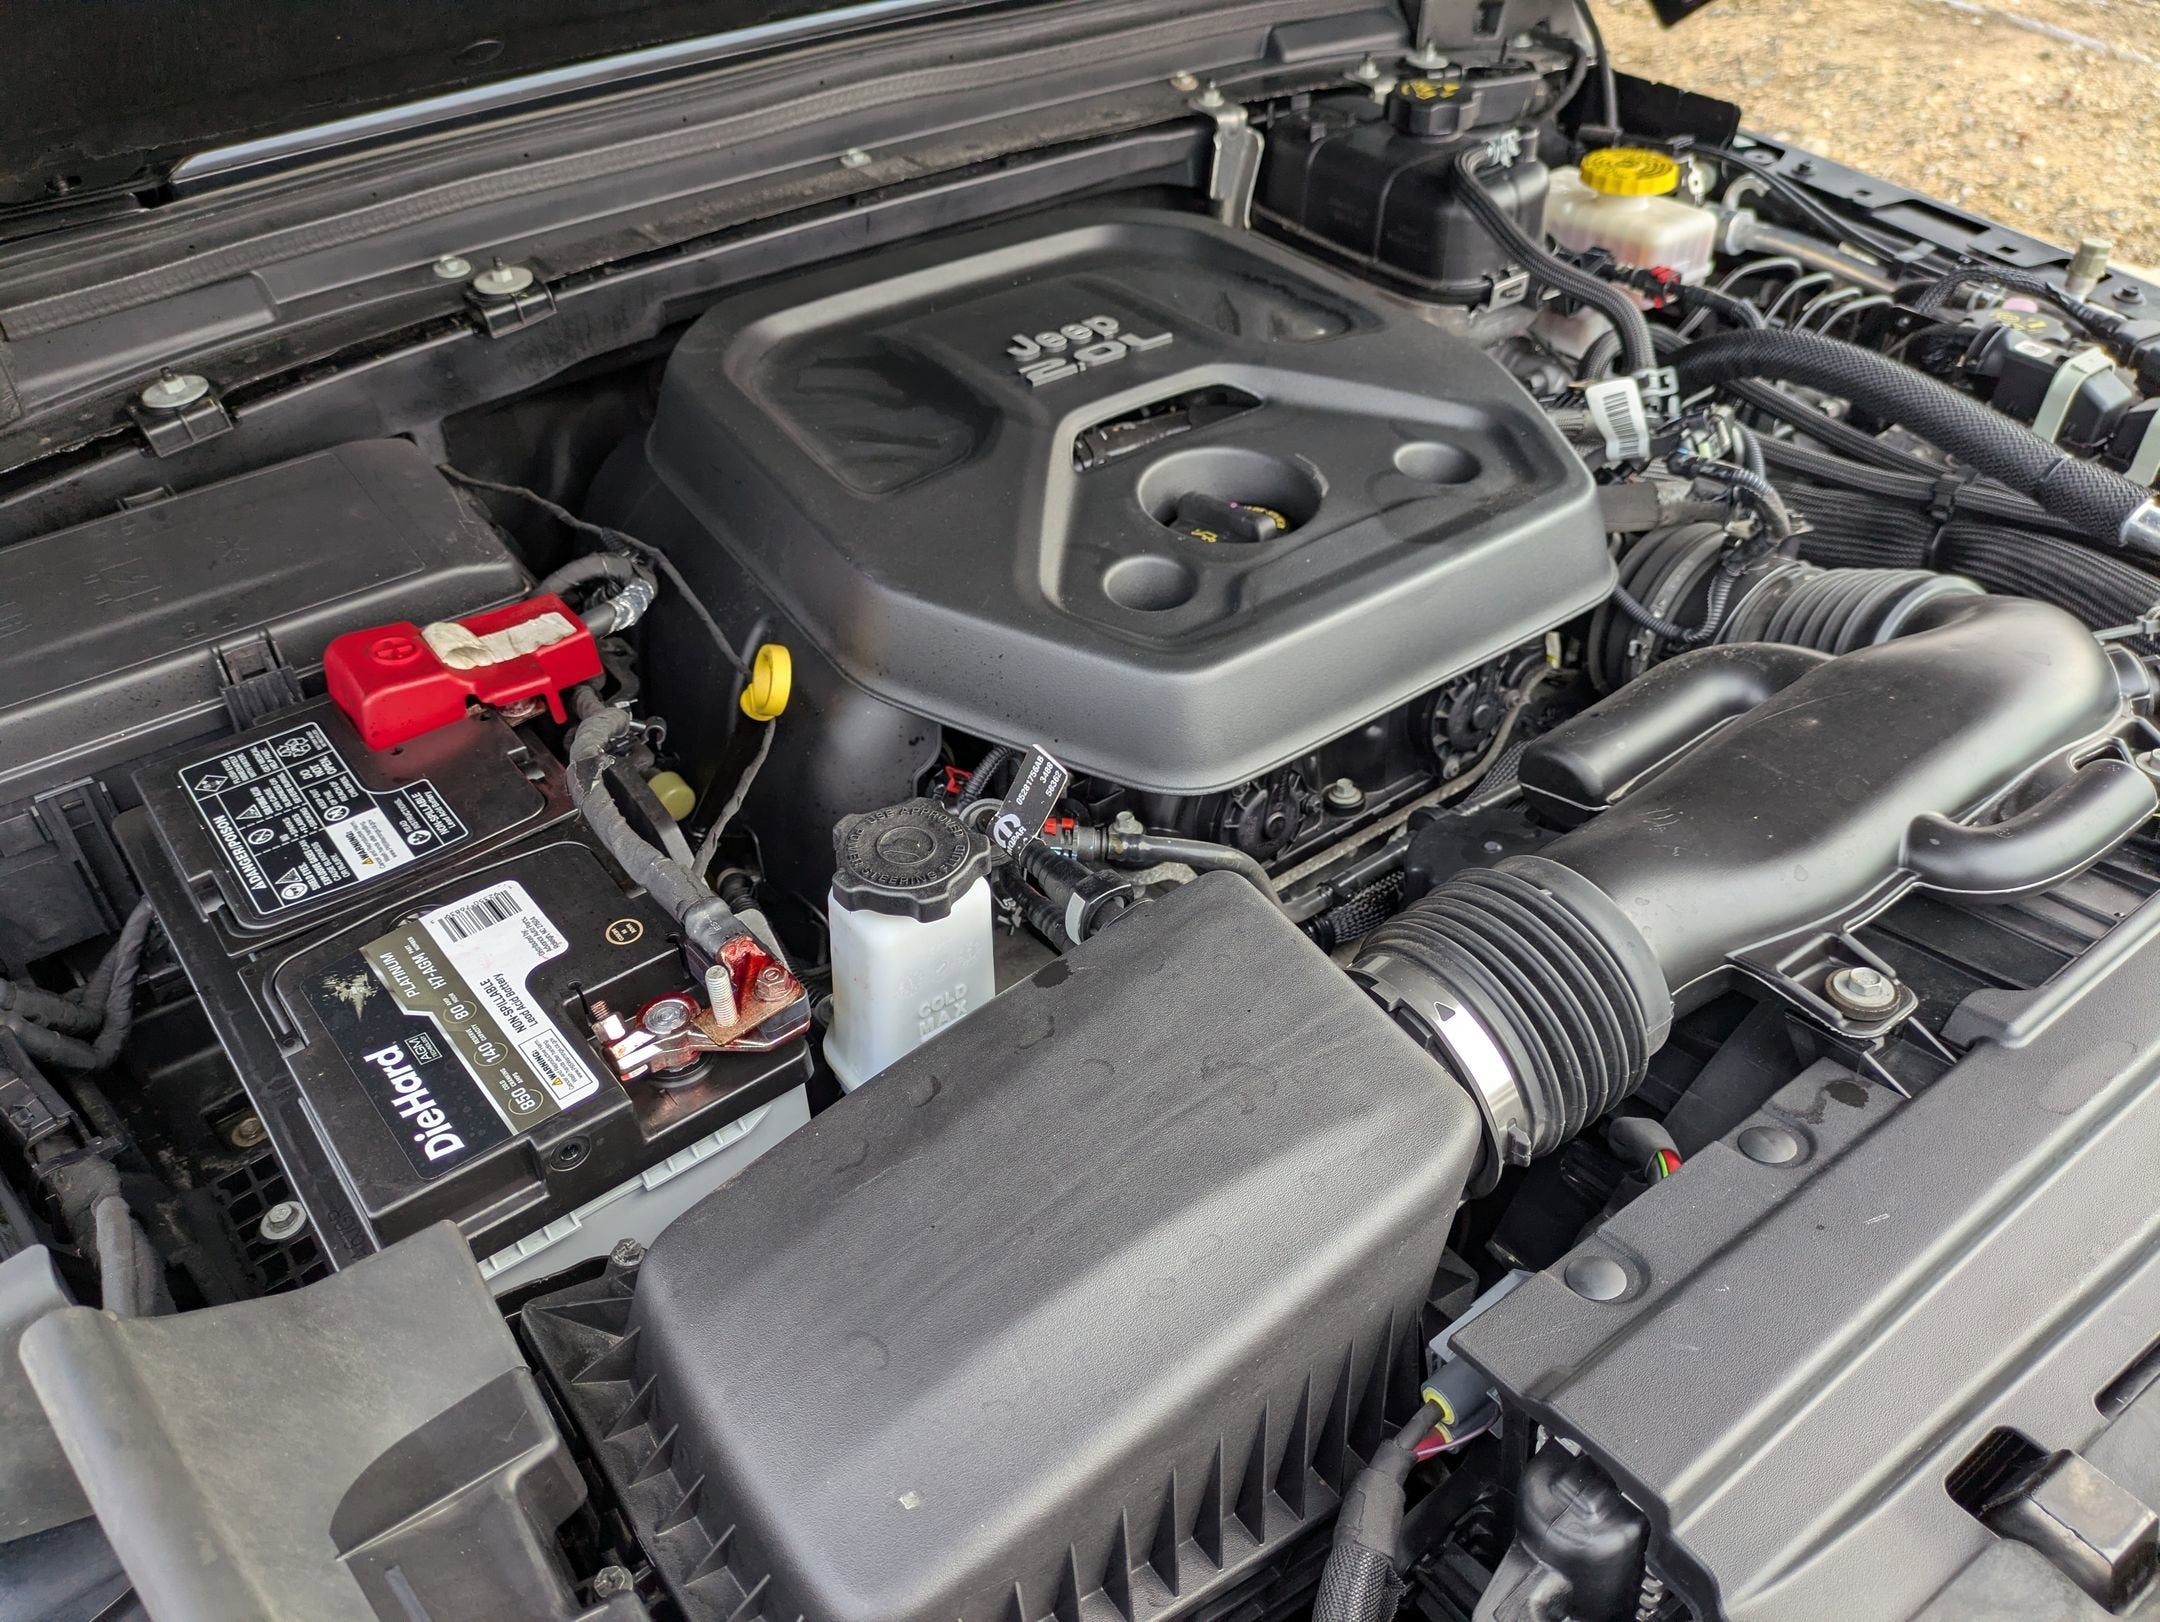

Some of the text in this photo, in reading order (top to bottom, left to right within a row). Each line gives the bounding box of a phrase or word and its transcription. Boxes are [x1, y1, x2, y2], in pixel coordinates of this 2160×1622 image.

[1007, 315, 1119, 361] Jeep
[1018, 332, 1173, 387] 2.0L
[1016, 755, 1044, 805] 05281756AB
[410, 791, 449, 835] NON-SPILLABLE
[421, 789, 456, 828] Lead Acid Battery
[866, 807, 964, 837] USE APPROVED
[212, 814, 262, 884] DANGER/POISON
[862, 868, 938, 885] STEERING
[940, 845, 965, 874] FLUID
[379, 951, 420, 998] PLATINUM
[410, 950, 447, 990] H7-AGM
[449, 1002, 469, 1020] 80
[478, 977, 527, 1034] NON-SPILLABLE
[490, 971, 538, 1027] Lead Acid Battery
[919, 983, 967, 1017] COLD
[920, 1000, 967, 1037] MAX
[409, 1036, 431, 1062] AGM
[476, 1040, 501, 1063] 140
[530, 1049, 557, 1080] WARNING:
[362, 1043, 465, 1160] DieHard
[509, 1085, 536, 1111] 850
